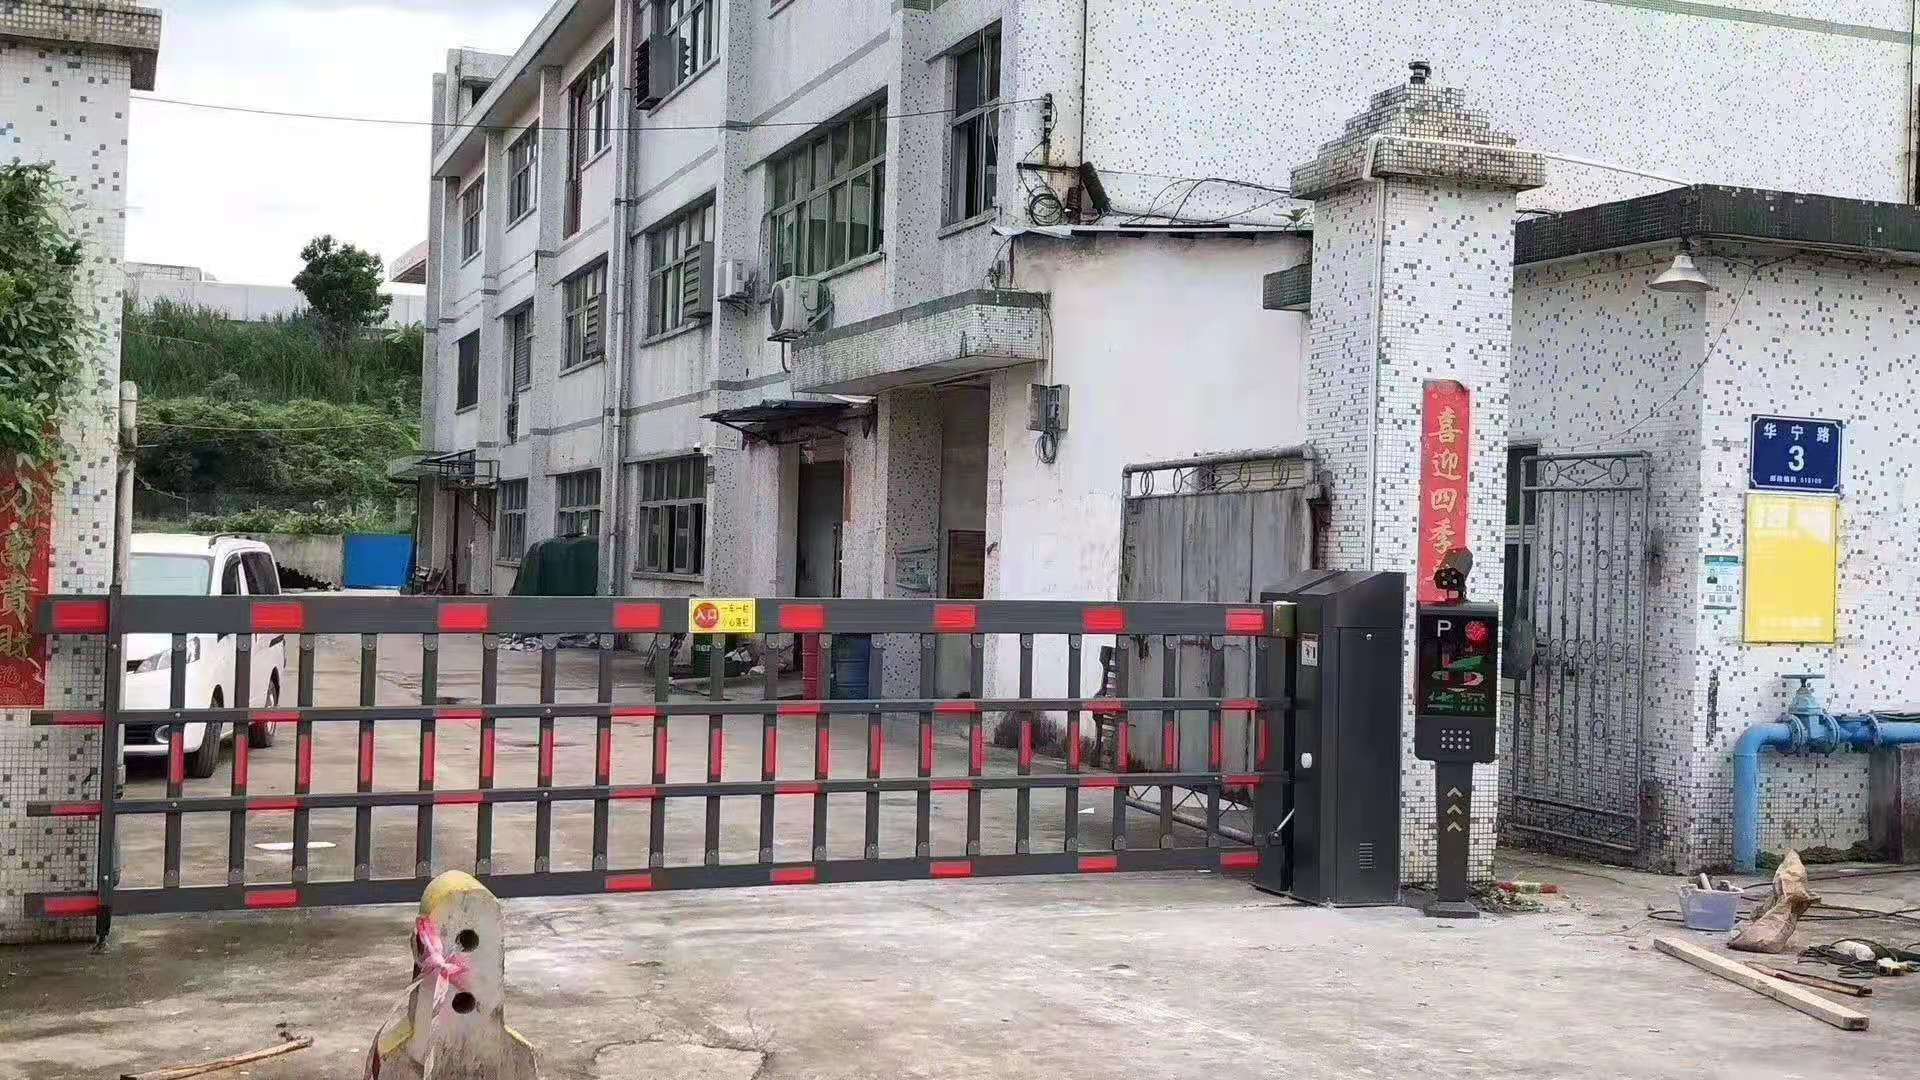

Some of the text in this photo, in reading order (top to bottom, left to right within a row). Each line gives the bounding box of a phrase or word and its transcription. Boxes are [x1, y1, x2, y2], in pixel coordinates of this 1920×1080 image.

[1764, 423, 1829, 443] 华宁路
[1789, 445, 1804, 471] 3
[1437, 619, 1452, 637] P
